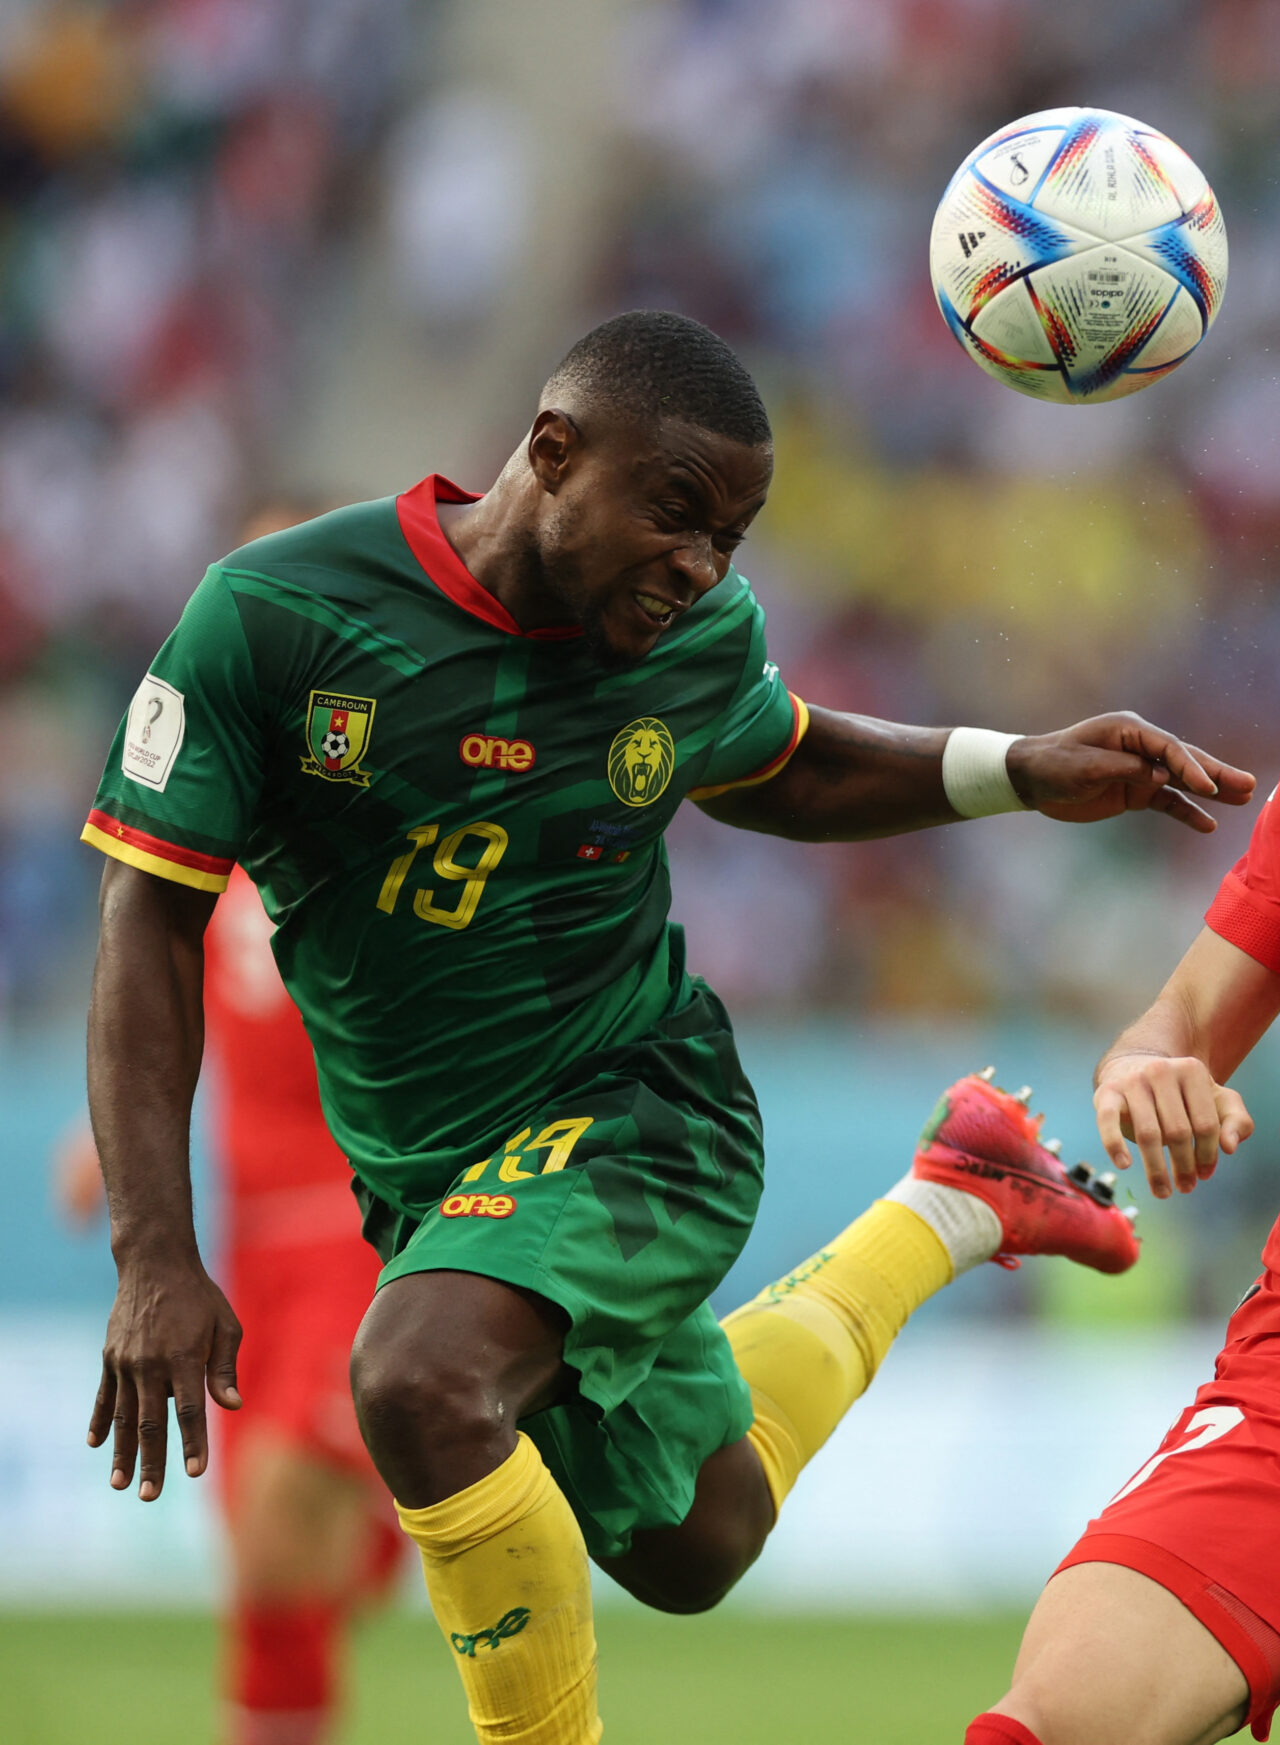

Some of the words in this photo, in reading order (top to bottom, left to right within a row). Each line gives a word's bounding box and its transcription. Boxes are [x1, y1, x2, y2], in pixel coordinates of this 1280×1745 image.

[1090, 289, 1124, 299] adidas
[317, 696, 368, 711] CAMEROUN
[149, 752, 162, 762] CUP
[461, 735, 534, 770] one
[376, 821, 509, 930] 19
[461, 1116, 595, 1184] 19
[440, 1193, 514, 1218] one
